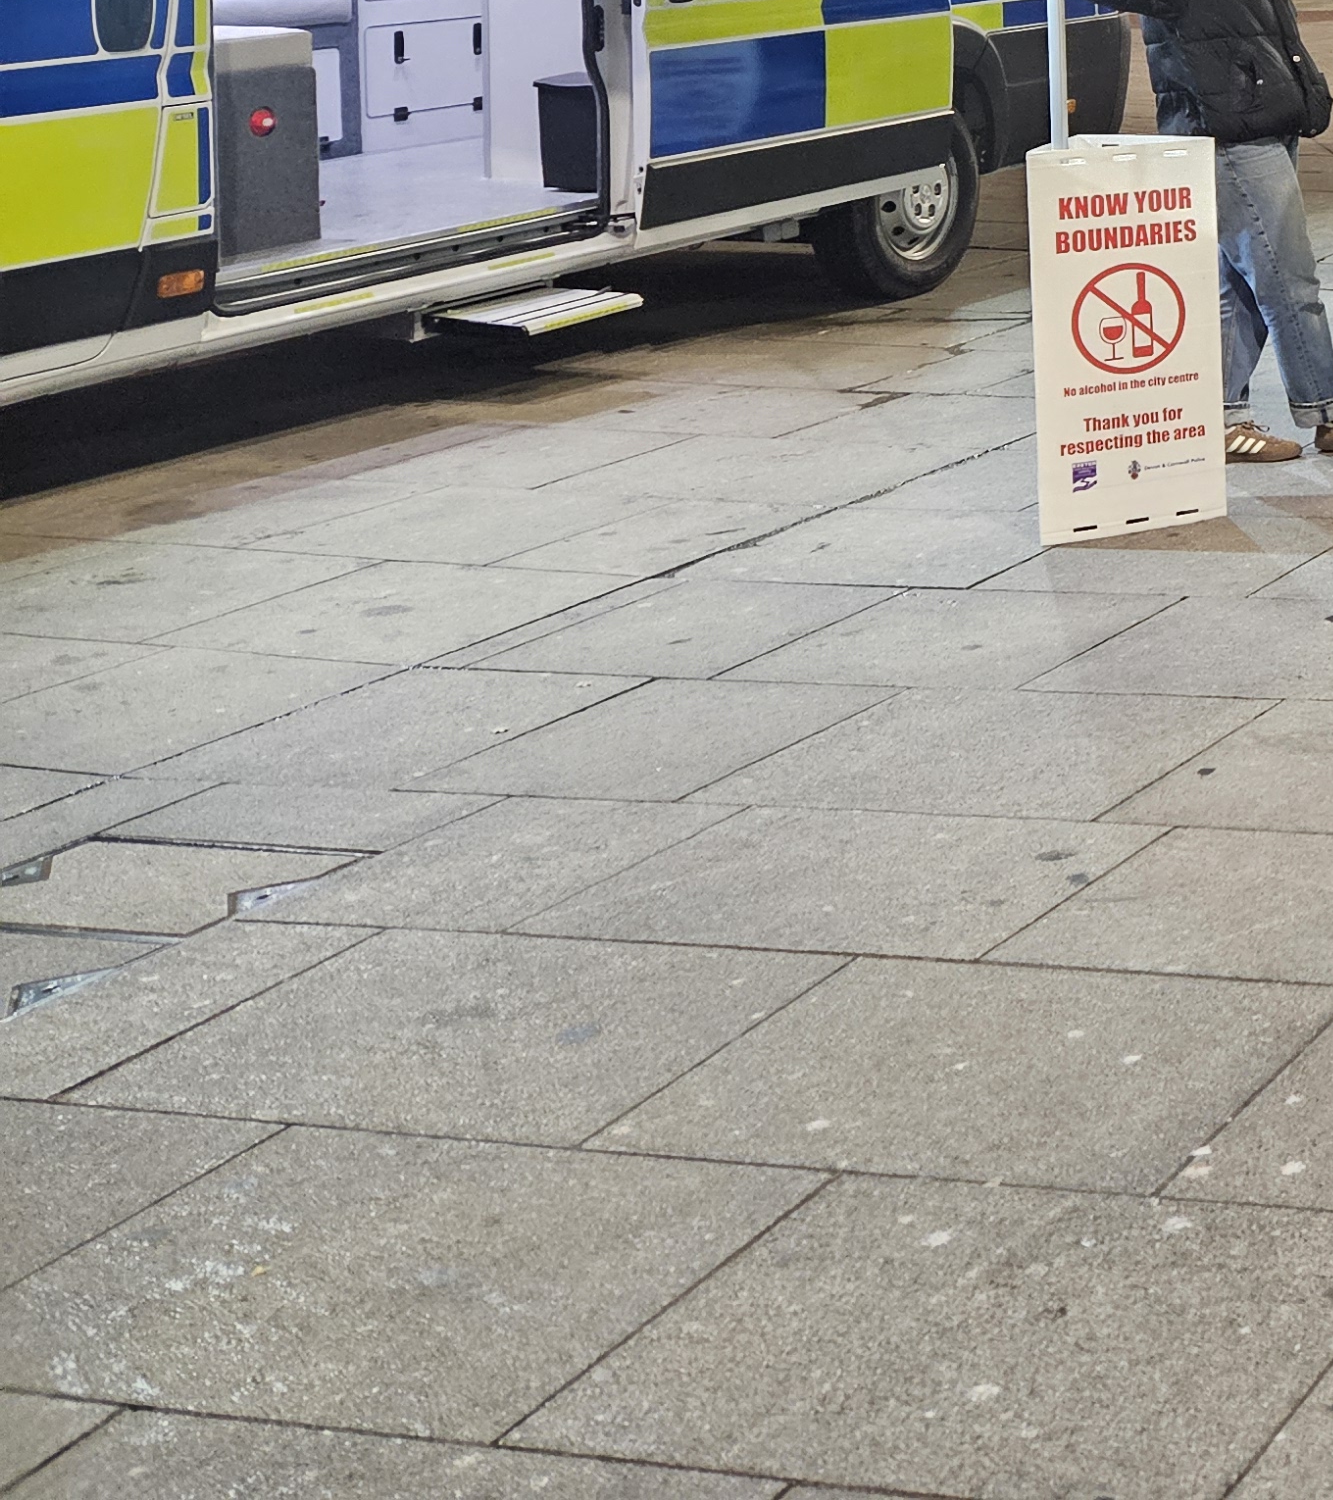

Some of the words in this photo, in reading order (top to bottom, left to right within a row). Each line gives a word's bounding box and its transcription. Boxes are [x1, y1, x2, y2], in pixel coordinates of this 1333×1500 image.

[1058, 192, 1129, 220] KNOW
[1133, 186, 1192, 214] YOUR
[1055, 219, 1197, 255] BOUNDARIES
[1063, 387, 1077, 397] No
[1079, 381, 1117, 395] alcohol
[1118, 380, 1128, 390] in
[1130, 378, 1146, 389] the
[1148, 376, 1167, 387] city
[1168, 372, 1199, 384] centre
[1083, 414, 1130, 432] Thank
[1133, 411, 1160, 428] you
[1162, 407, 1184, 422] for
[1060, 434, 1144, 457] respecting
[1146, 429, 1171, 444] the
[1173, 424, 1206, 441] area
